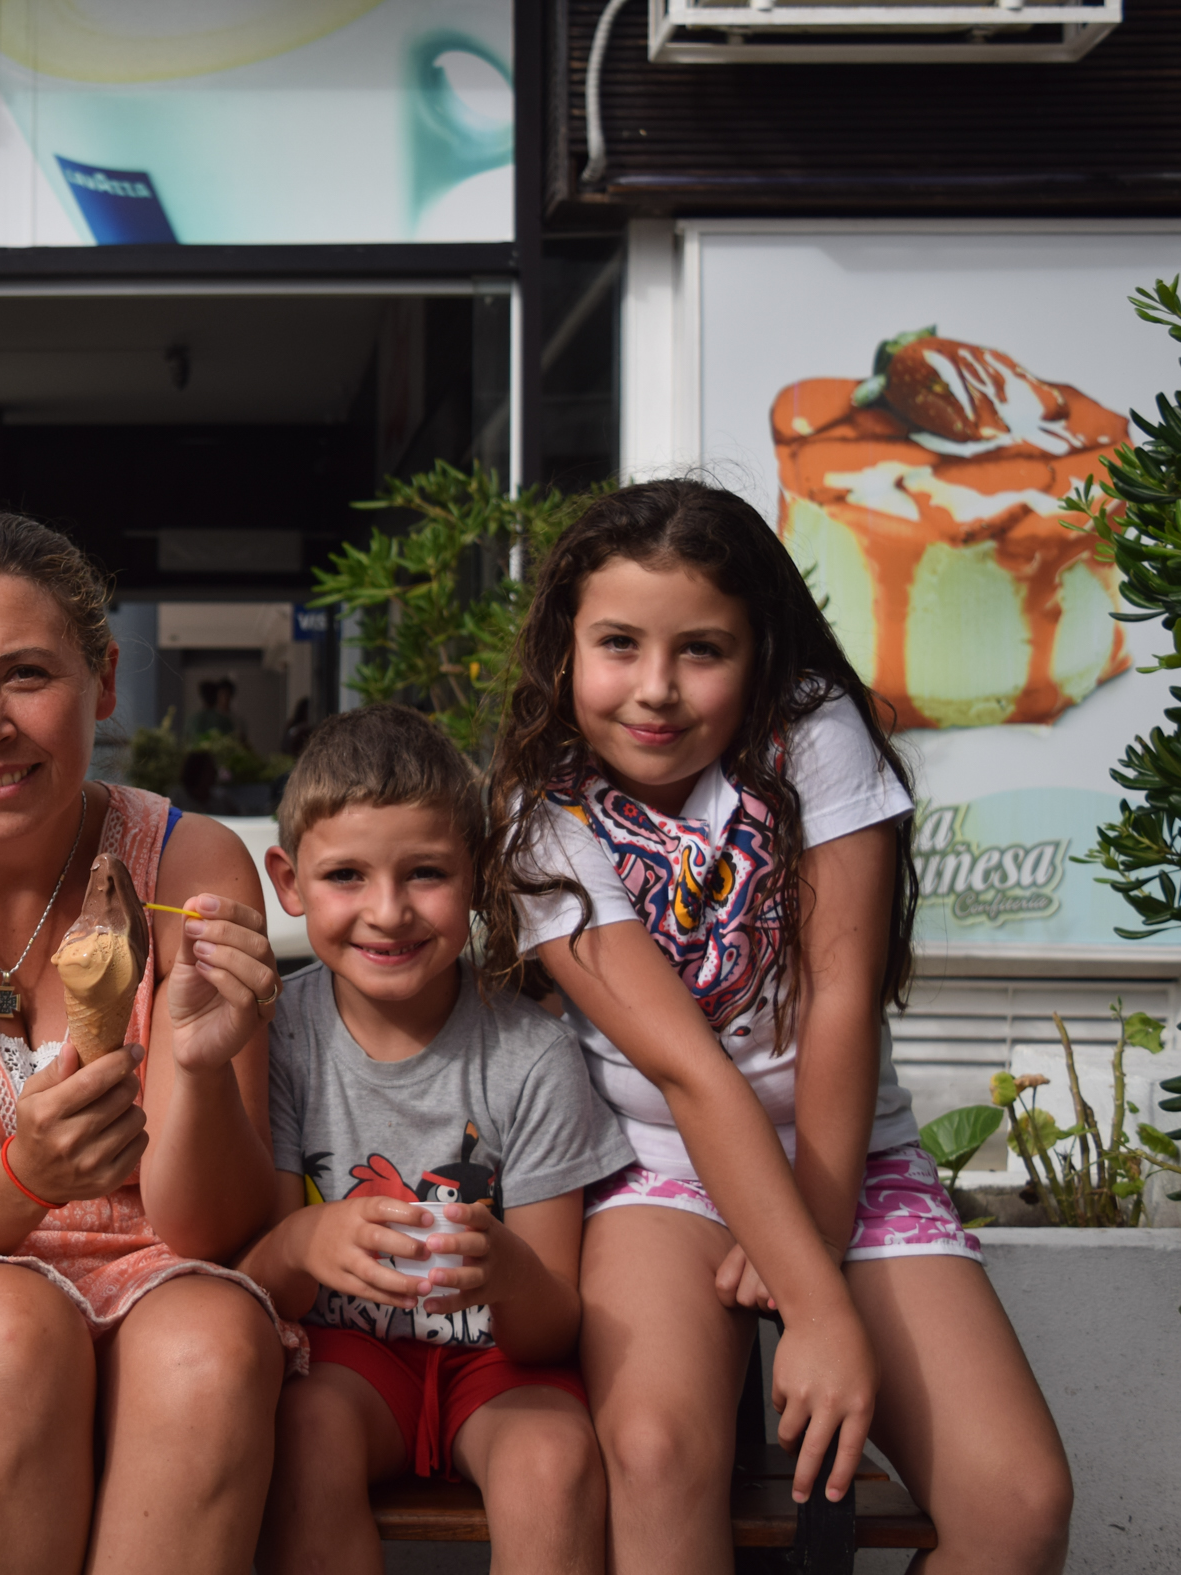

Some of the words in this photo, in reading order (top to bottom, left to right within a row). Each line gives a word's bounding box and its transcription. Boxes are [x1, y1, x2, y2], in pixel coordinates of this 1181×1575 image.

[298, 612, 333, 631] VIS
[915, 809, 955, 852] a
[912, 844, 1058, 896] uñesa
[317, 1290, 395, 1342] GRY
[402, 1295, 493, 1347] BIR
